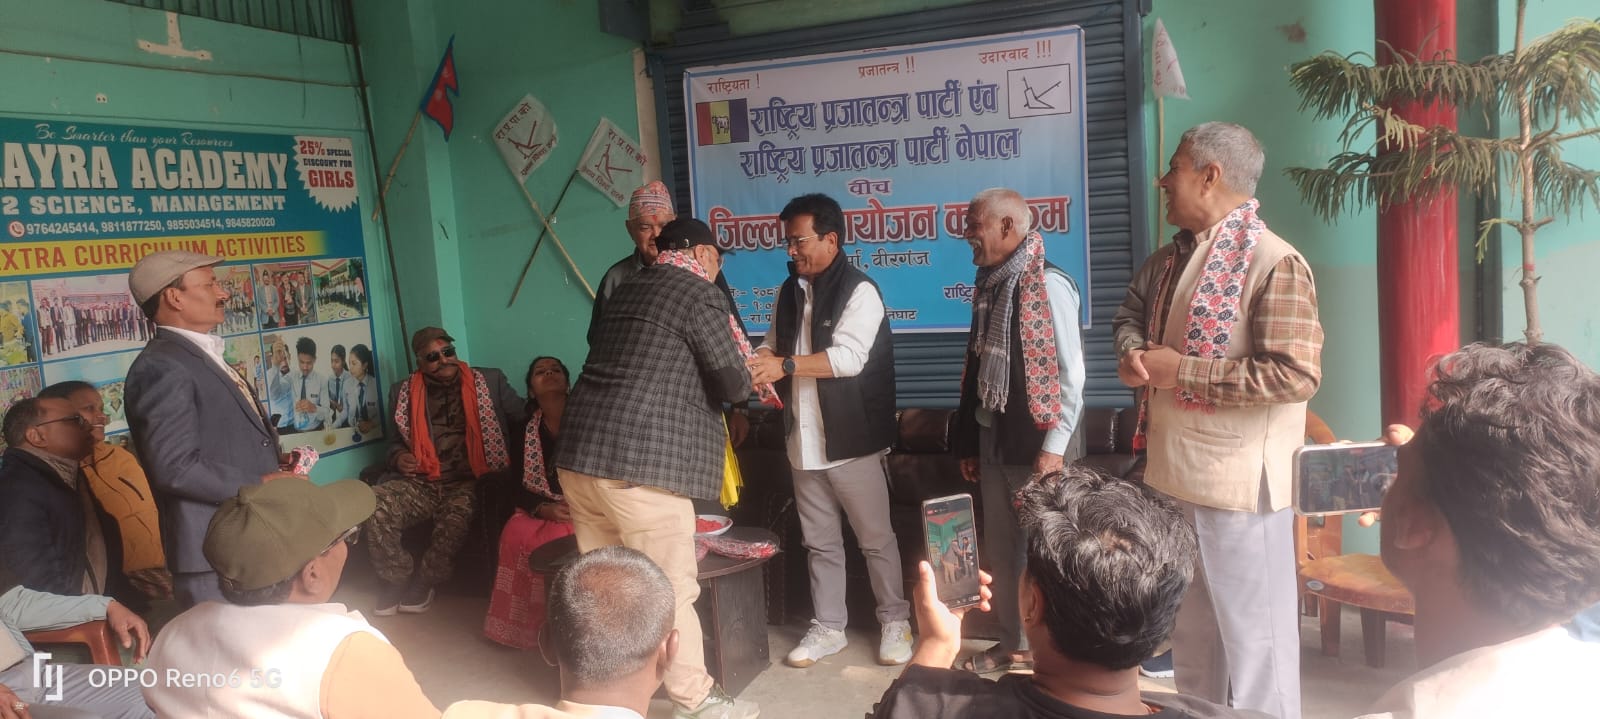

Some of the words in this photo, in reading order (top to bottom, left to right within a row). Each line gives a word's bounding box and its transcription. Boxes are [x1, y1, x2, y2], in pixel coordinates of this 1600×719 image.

[979, 47, 1029, 65] उदारवाद
[858, 62, 900, 79] प्रजातन्त्र
[707, 77, 750, 95] राष्ट्रियता
[749, 96, 816, 141] राष्ट्रिय
[821, 93, 911, 133] प्रजातन्त्र
[915, 79, 961, 119] पार्टी
[34, 123, 57, 140] Be
[62, 125, 116, 143] Smarter
[119, 129, 148, 144] than
[152, 134, 178, 148] your
[180, 132, 234, 148] Resources
[299, 140, 325, 156] 25%
[326, 148, 352, 157] SPECIAL
[739, 140, 807, 183] राष्ट्रिय
[810, 139, 898, 176] प्रजातन्त्र
[903, 126, 949, 165] पार्टी
[954, 124, 1021, 161] नेपाल
[0, 142, 119, 190] AYRA
[131, 147, 289, 191] ACADEMY
[303, 158, 337, 167] DISCOUNT
[339, 159, 353, 168] FOR
[308, 169, 354, 189] GIRLS
[29, 195, 143, 216] SCIENCE,
[150, 194, 286, 213] MANAGEMENT
[26, 221, 100, 235] 9764245414,
[101, 219, 165, 233] 9811877250,
[166, 218, 224, 231] 9855034514,
[225, 216, 276, 229] 9845820020
[708, 206, 786, 251] जिल्ल
[0, 246, 67, 272] XTRA
[215, 235, 306, 258] ACTIVITIES
[871, 247, 930, 268] वीरगंज
